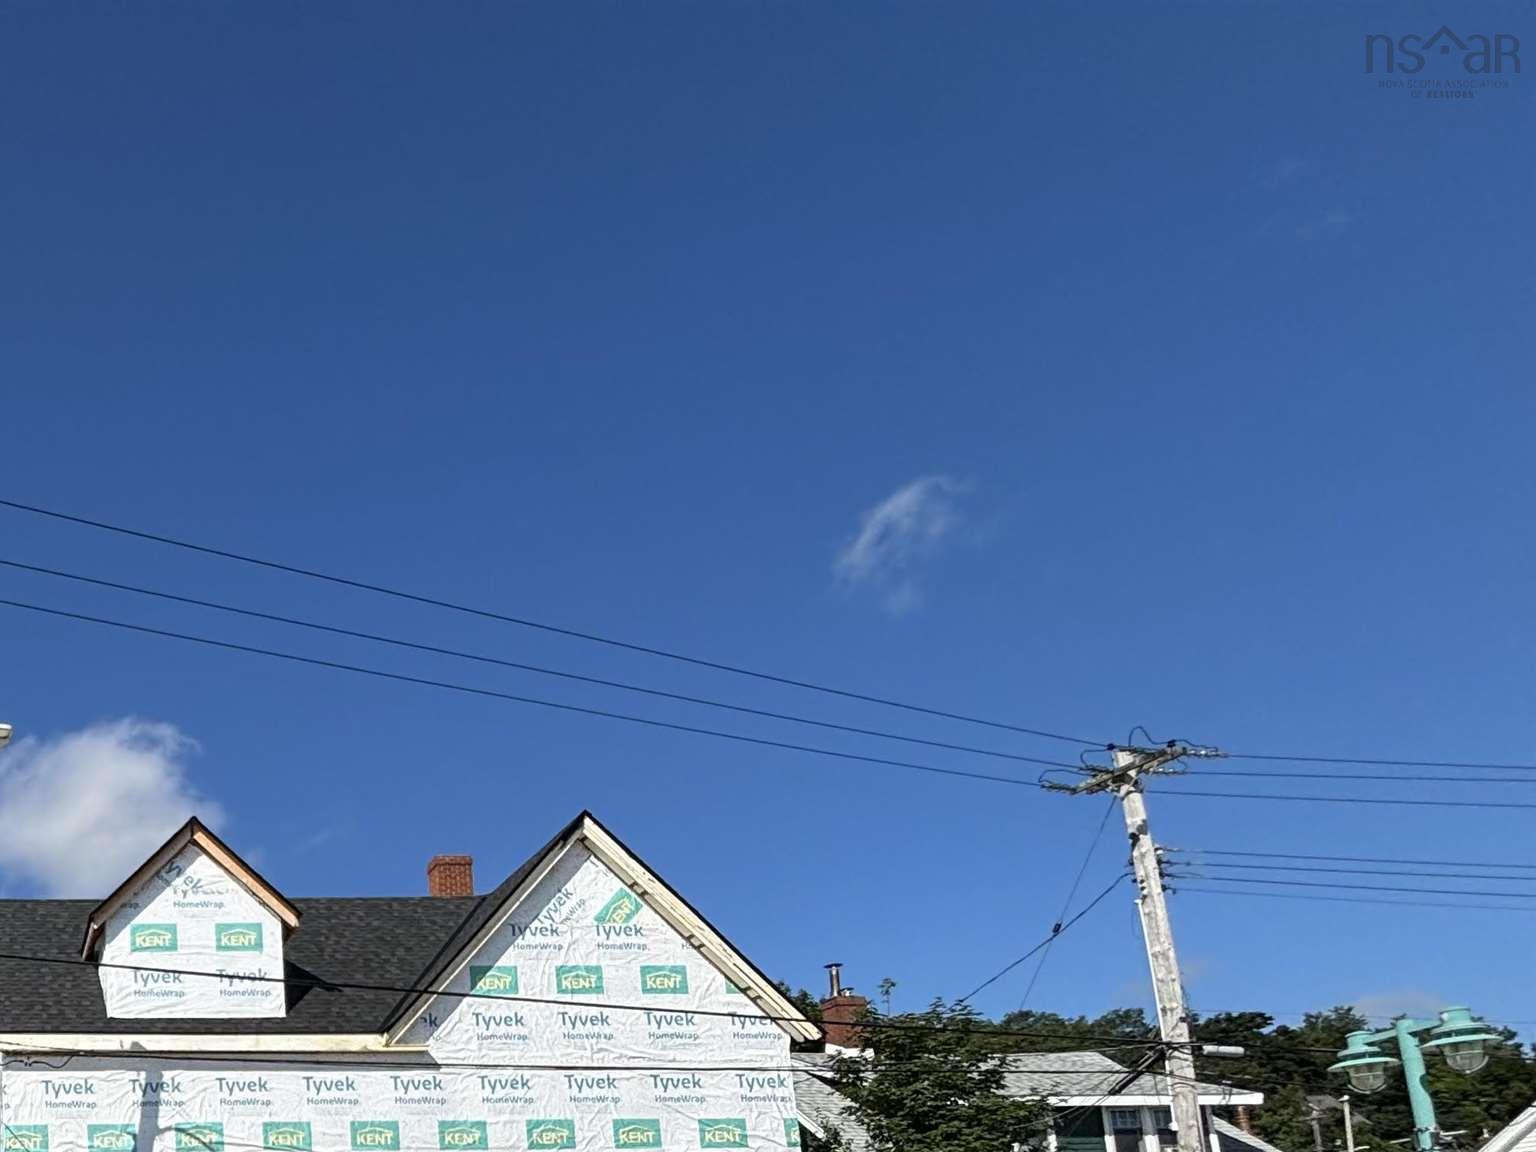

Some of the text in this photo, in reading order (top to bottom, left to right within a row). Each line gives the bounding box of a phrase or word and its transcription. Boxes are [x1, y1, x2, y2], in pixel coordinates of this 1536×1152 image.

[173, 901, 225, 909] HomeWrap
[507, 923, 560, 940] Tyvek
[135, 935, 172, 948] KENT
[221, 935, 257, 946] KENT
[597, 943, 648, 951] HomeWrap
[477, 976, 511, 990] KENT
[561, 976, 597, 989] KENT
[646, 975, 682, 989] KENT
[134, 989, 185, 998] HomeWrap
[220, 989, 271, 997] HomeWrap
[472, 1011, 525, 1030] Tyvek
[559, 1010, 610, 1028] Tyvek
[644, 1011, 696, 1029] Tyvek
[477, 1033, 528, 1041] HomeWrap
[563, 1032, 614, 1040] HomeWrap
[648, 1031, 699, 1041] HomeWrap
[733, 1032, 782, 1040] HomeWrap
[41, 1079, 94, 1098] Tyvek
[129, 1078, 181, 1097] Tyvek
[216, 1077, 268, 1096] Tyvek
[303, 1076, 356, 1095] Tyvek
[390, 1075, 443, 1094] Tyvek
[478, 1075, 530, 1093] Tyvek
[564, 1074, 617, 1093] Tyvek
[650, 1074, 702, 1092] Tyvek
[736, 1073, 788, 1092] Tyvek
[133, 1099, 184, 1108] HomeWrap
[220, 1098, 270, 1107] HomeWrap
[307, 1098, 359, 1106] HomeWrap
[395, 1096, 446, 1105] HomeWrap
[482, 1096, 534, 1104] HomeWrap
[569, 1095, 620, 1104] HomeWrap
[655, 1094, 706, 1103] HomeWrap
[45, 1101, 96, 1109] HomeWrap
[269, 1133, 304, 1145] KENT
[357, 1133, 392, 1144] KENT
[445, 1132, 480, 1144] KENT
[533, 1132, 569, 1144] KENT
[620, 1132, 655, 1143] KENT
[704, 1131, 740, 1143] KENT
